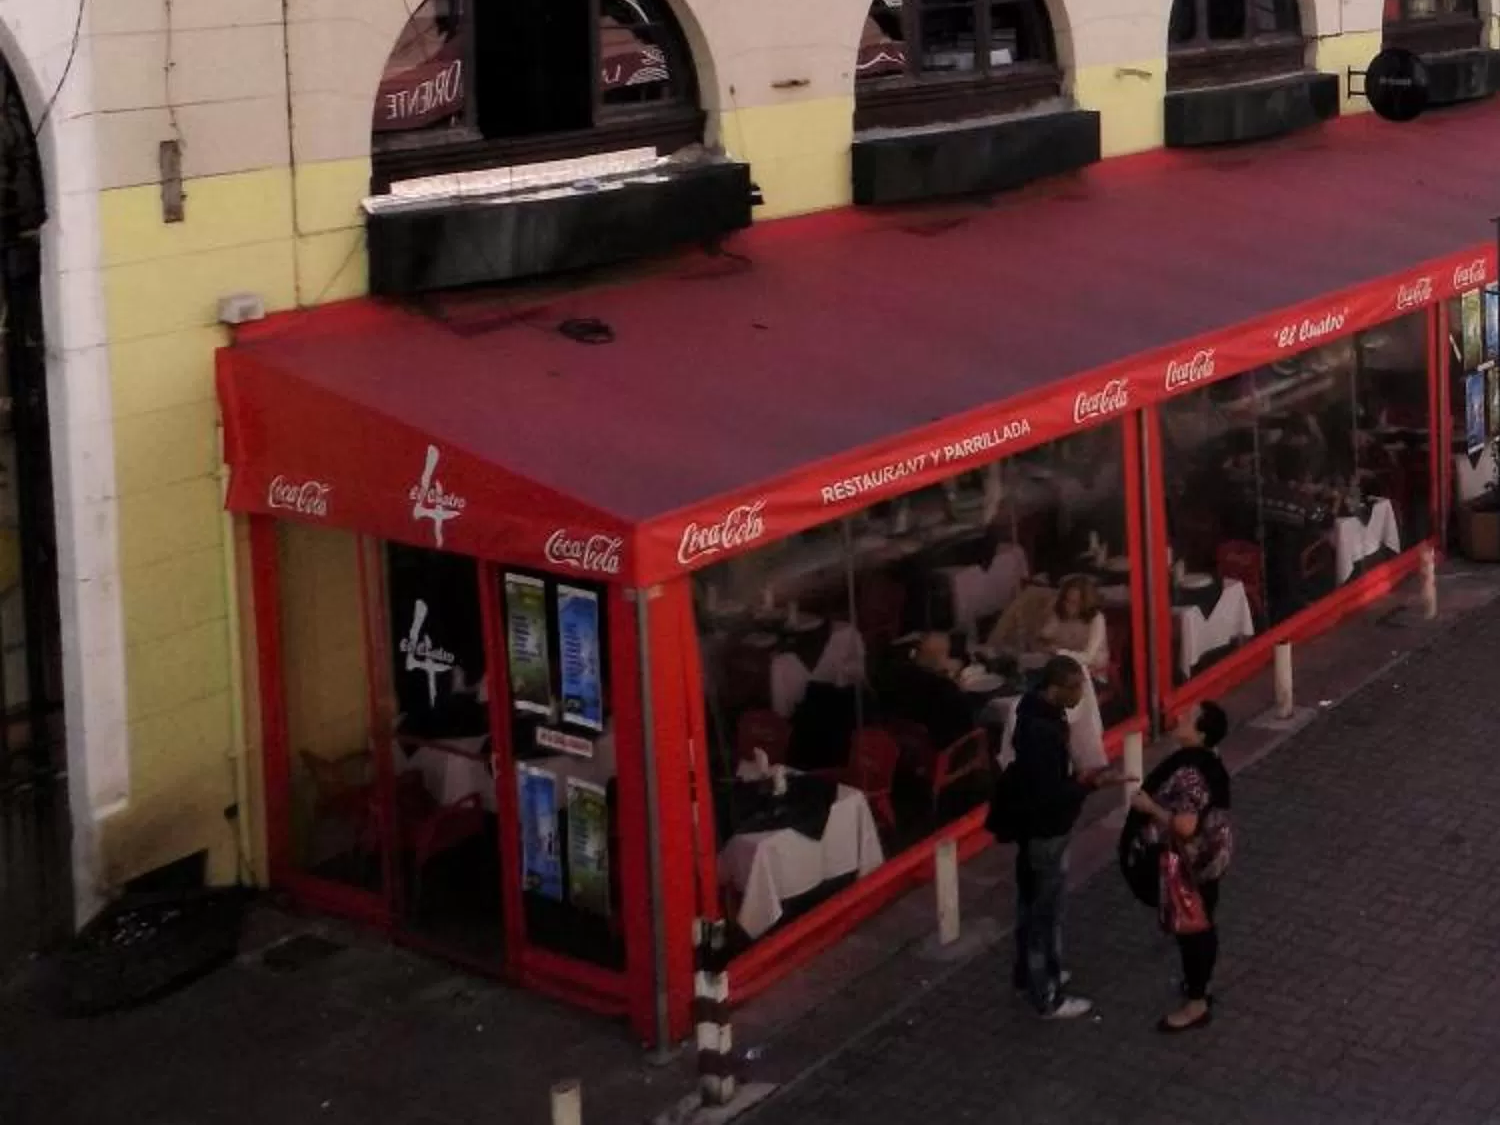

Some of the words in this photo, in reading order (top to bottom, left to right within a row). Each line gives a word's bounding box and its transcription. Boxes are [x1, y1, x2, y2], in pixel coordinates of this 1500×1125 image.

[820, 453, 927, 505] RESTAURANT
[928, 448, 942, 465] Y
[943, 418, 1032, 462] PARRILLADA
